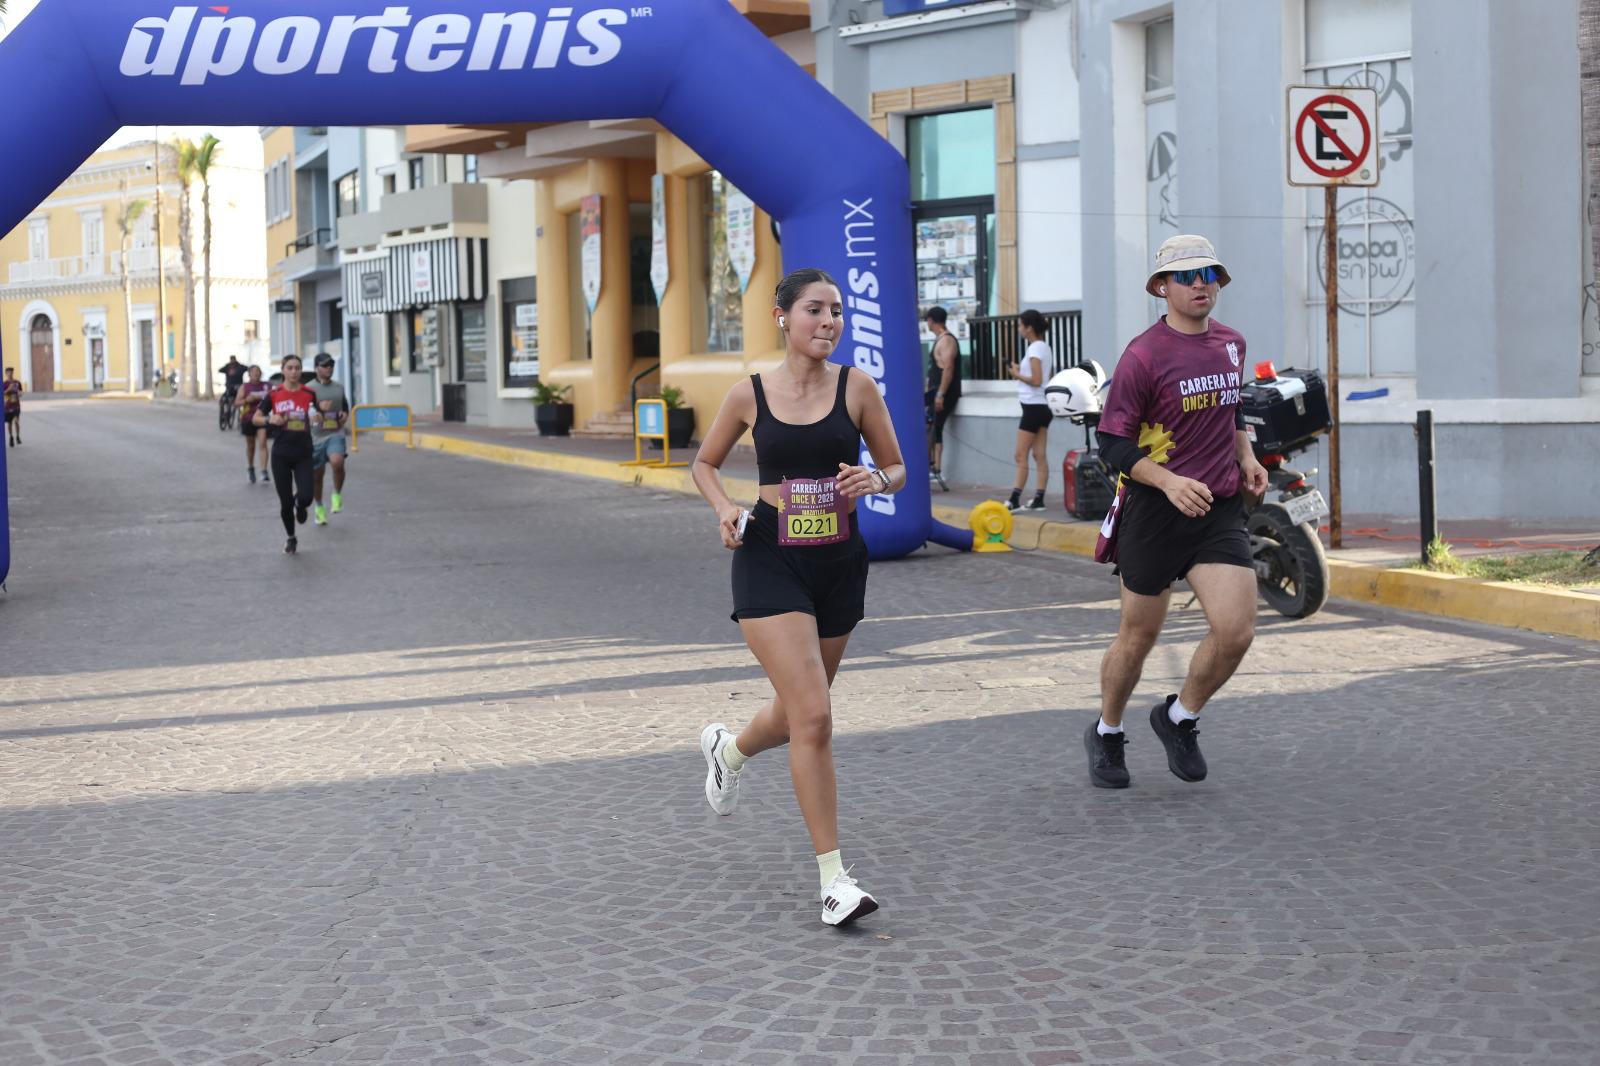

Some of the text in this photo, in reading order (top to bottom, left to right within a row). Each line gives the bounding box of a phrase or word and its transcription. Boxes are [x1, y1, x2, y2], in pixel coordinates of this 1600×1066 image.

[119, 6, 653, 86] dportenis MR
[1315, 110, 1349, 160] E
[1338, 237, 1398, 259] boba
[1179, 373, 1226, 395] CARRERA
[1182, 393, 1209, 413] ONCE
[1211, 391, 1218, 407] K
[791, 481, 834, 494] CARRERA IPN
[791, 492, 834, 505] ONCE K 2026
[791, 517, 832, 535] 0221
